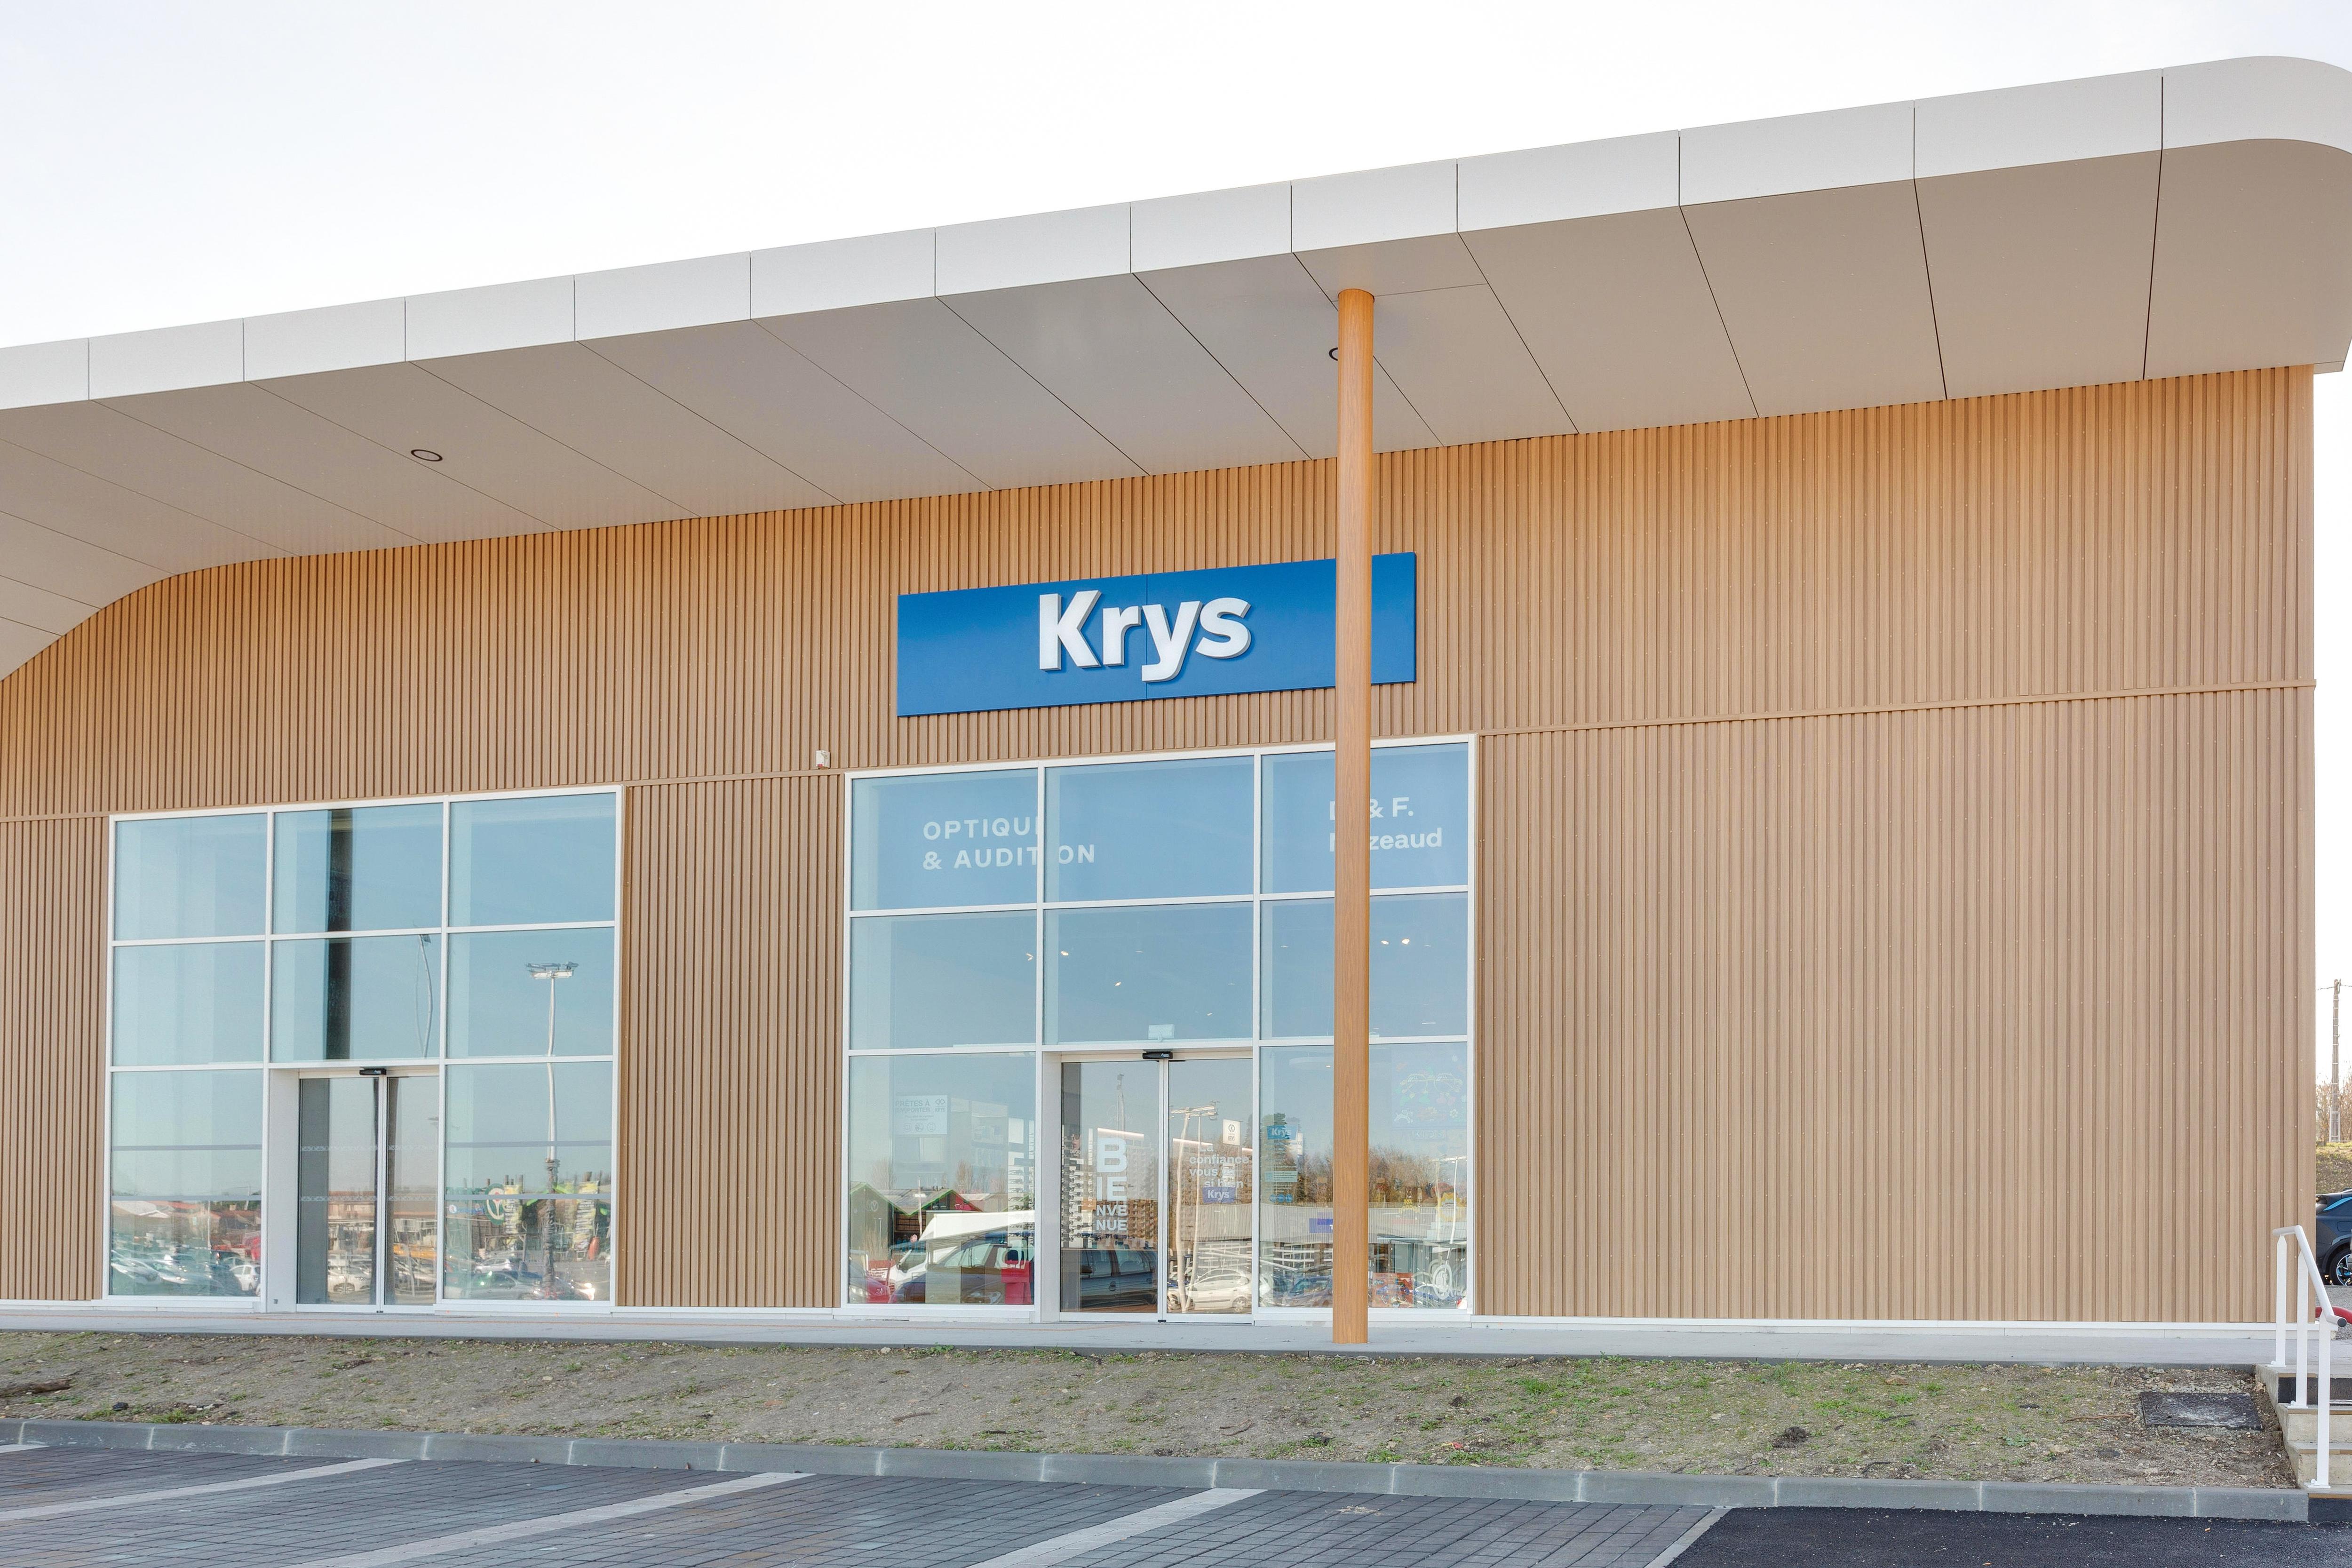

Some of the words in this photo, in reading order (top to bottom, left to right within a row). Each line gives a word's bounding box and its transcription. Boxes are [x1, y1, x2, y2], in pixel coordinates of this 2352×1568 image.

[1040, 590, 1251, 683] Krys
[1392, 797, 1414, 817] F.
[923, 816, 1038, 840] OPTIQU
[922, 851, 942, 870] &
[954, 844, 1095, 869] AUDITON
[896, 1098, 923, 1107] PRÊTES
[1097, 1137, 1127, 1172] B
[1189, 1154, 1249, 1164] confiance
[1189, 1168, 1218, 1177] vous
[1097, 1176, 1127, 1201] IE
[1204, 1179, 1214, 1188] si
[1208, 1189, 1230, 1200] Krys
[1096, 1204, 1127, 1216] NVE
[1096, 1219, 1127, 1231] NUE
